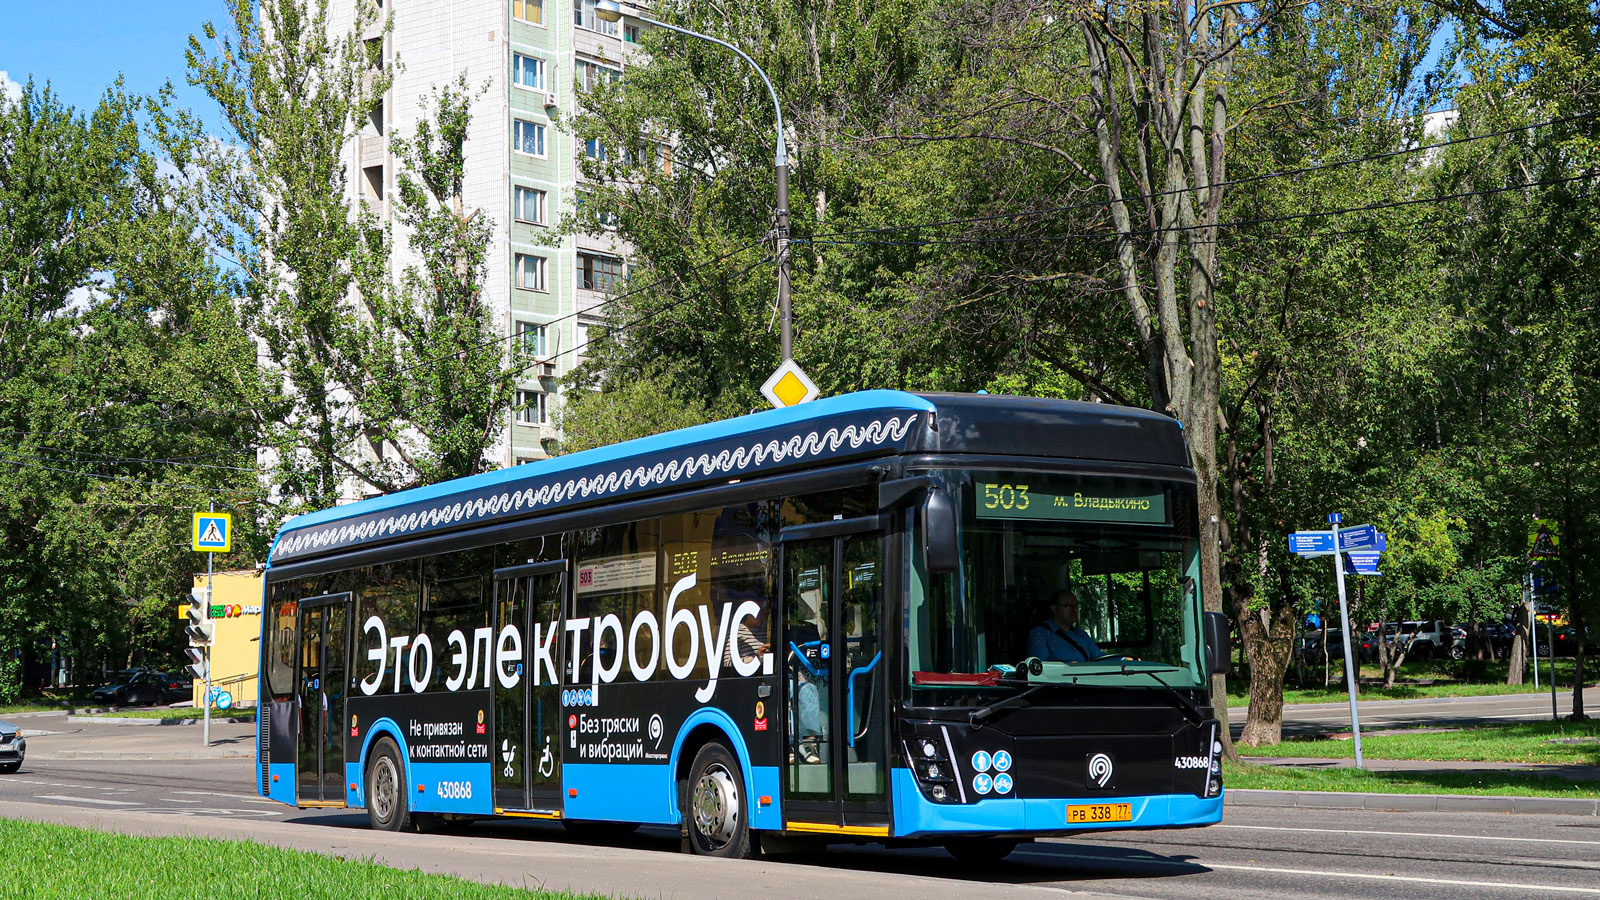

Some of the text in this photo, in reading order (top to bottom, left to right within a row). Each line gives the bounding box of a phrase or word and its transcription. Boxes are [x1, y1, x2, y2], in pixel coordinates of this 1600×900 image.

[984, 484, 1030, 510] 503
[1053, 492, 1151, 511] м. Владыкино
[580, 571, 592, 584] 503
[360, 615, 433, 696] Это
[409, 719, 463, 740] Не привязан
[580, 713, 640, 738] Без тряски
[409, 740, 488, 758] к контактной сети
[580, 737, 644, 763] и вибраций
[1174, 756, 1209, 769] 430868
[437, 781, 473, 799] 430868
[1090, 806, 1111, 820] 338
[1117, 804, 1128, 816] 77
